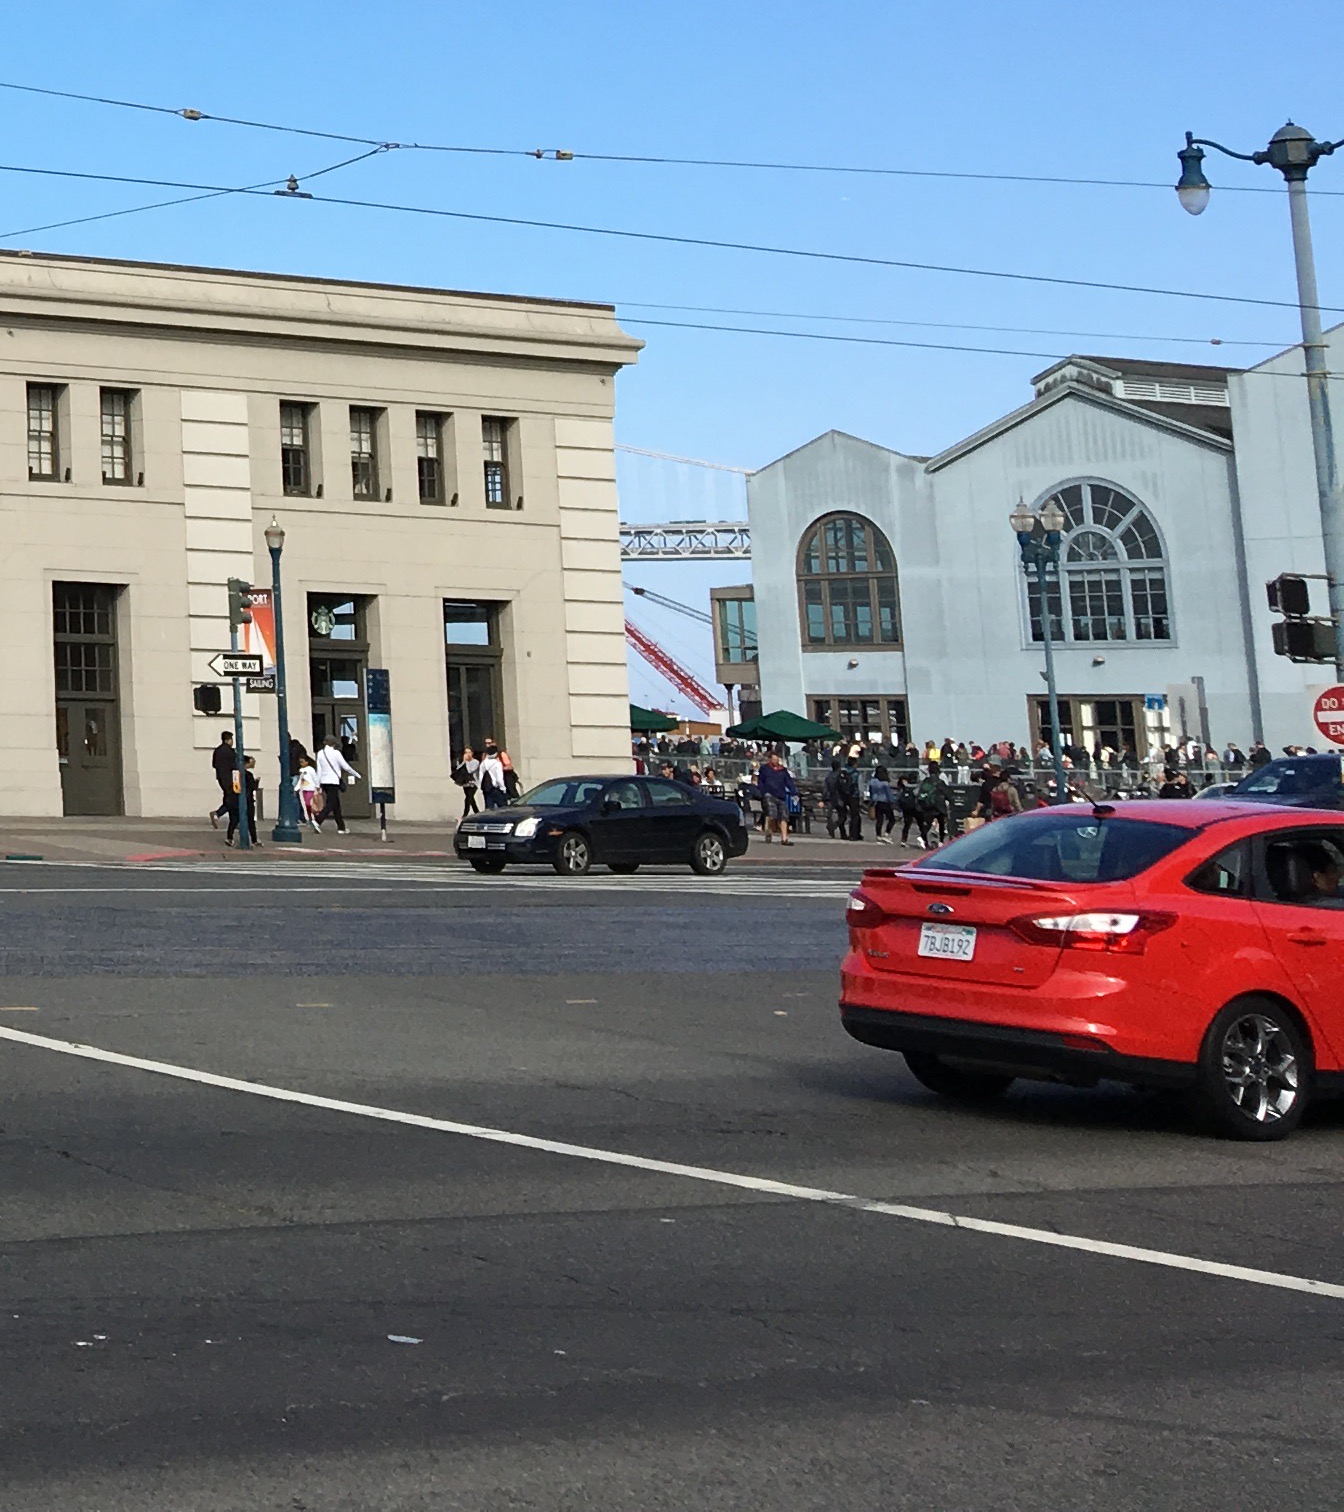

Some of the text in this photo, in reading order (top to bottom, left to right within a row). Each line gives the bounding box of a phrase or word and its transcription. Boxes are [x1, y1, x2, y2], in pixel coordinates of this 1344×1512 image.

[223, 660, 257, 670] ONE WAY
[249, 678, 274, 689] SAILING
[1321, 697, 1339, 709] DO
[923, 934, 971, 956] 7BJB192
